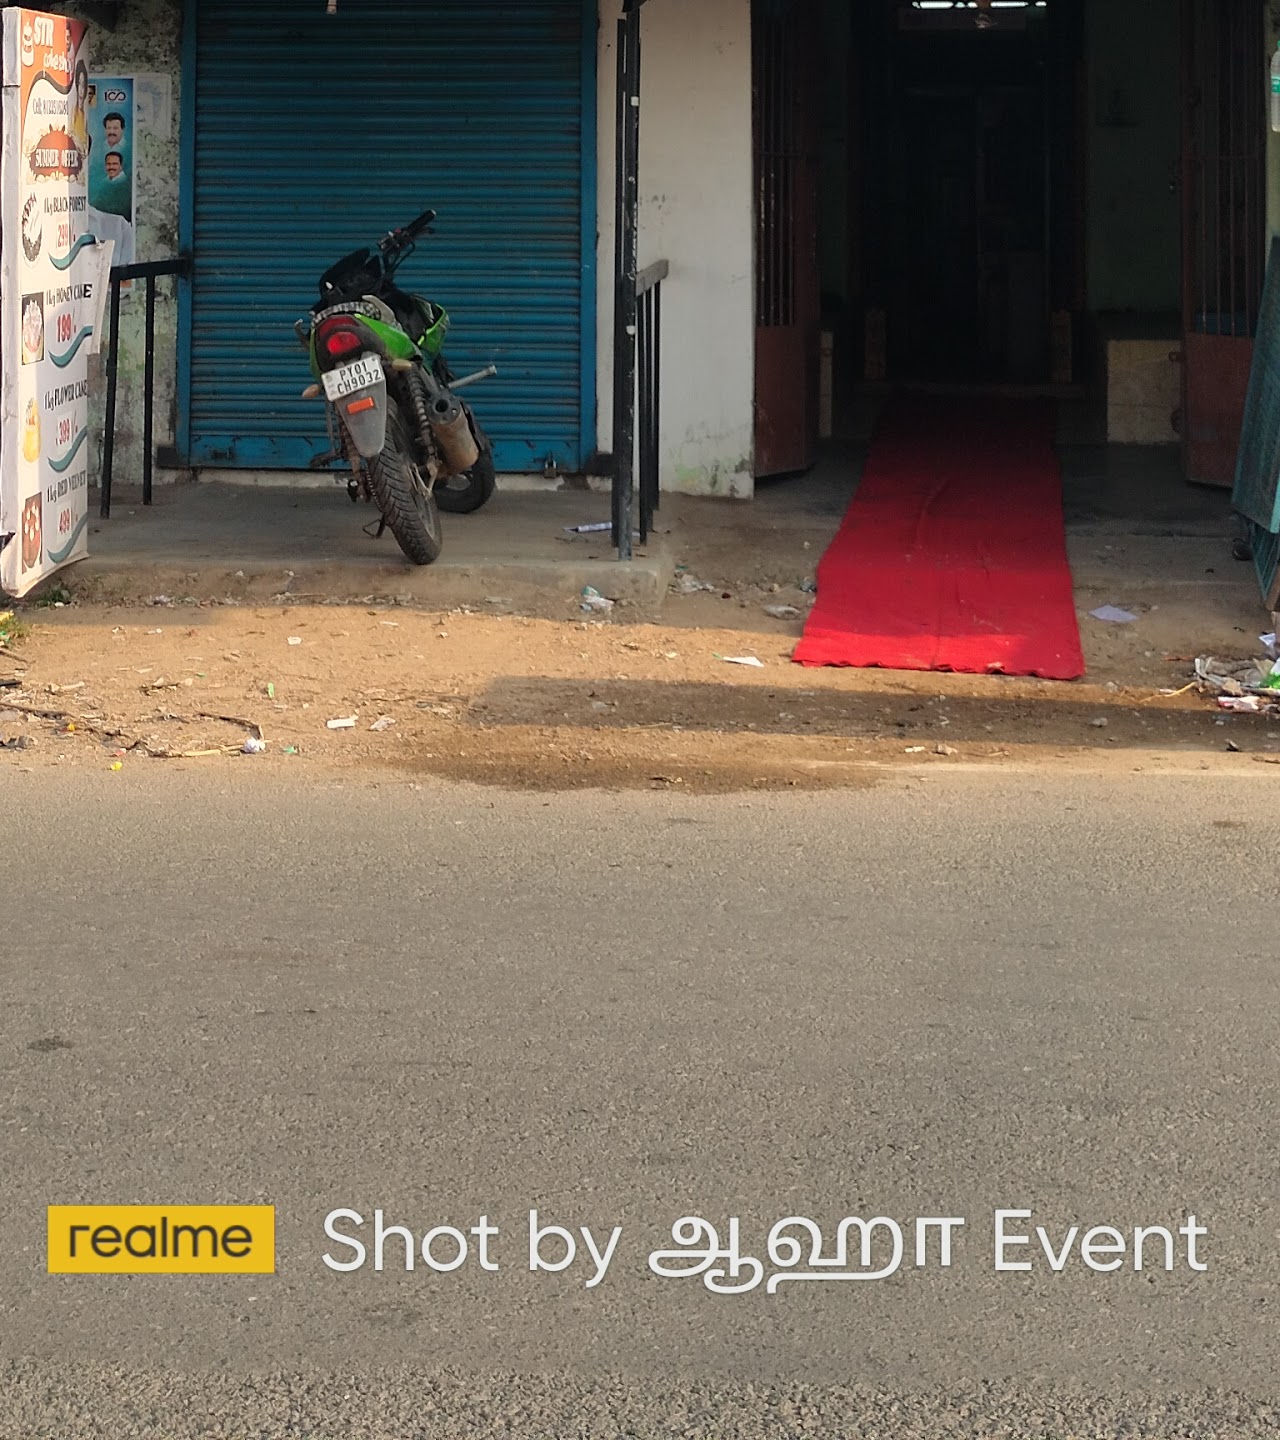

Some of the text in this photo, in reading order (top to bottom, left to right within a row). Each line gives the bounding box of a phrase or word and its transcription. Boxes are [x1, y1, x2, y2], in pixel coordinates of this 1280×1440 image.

[34, 16, 54, 47] STR
[337, 369, 381, 395] CH9032
[340, 360, 368, 381] PY01
